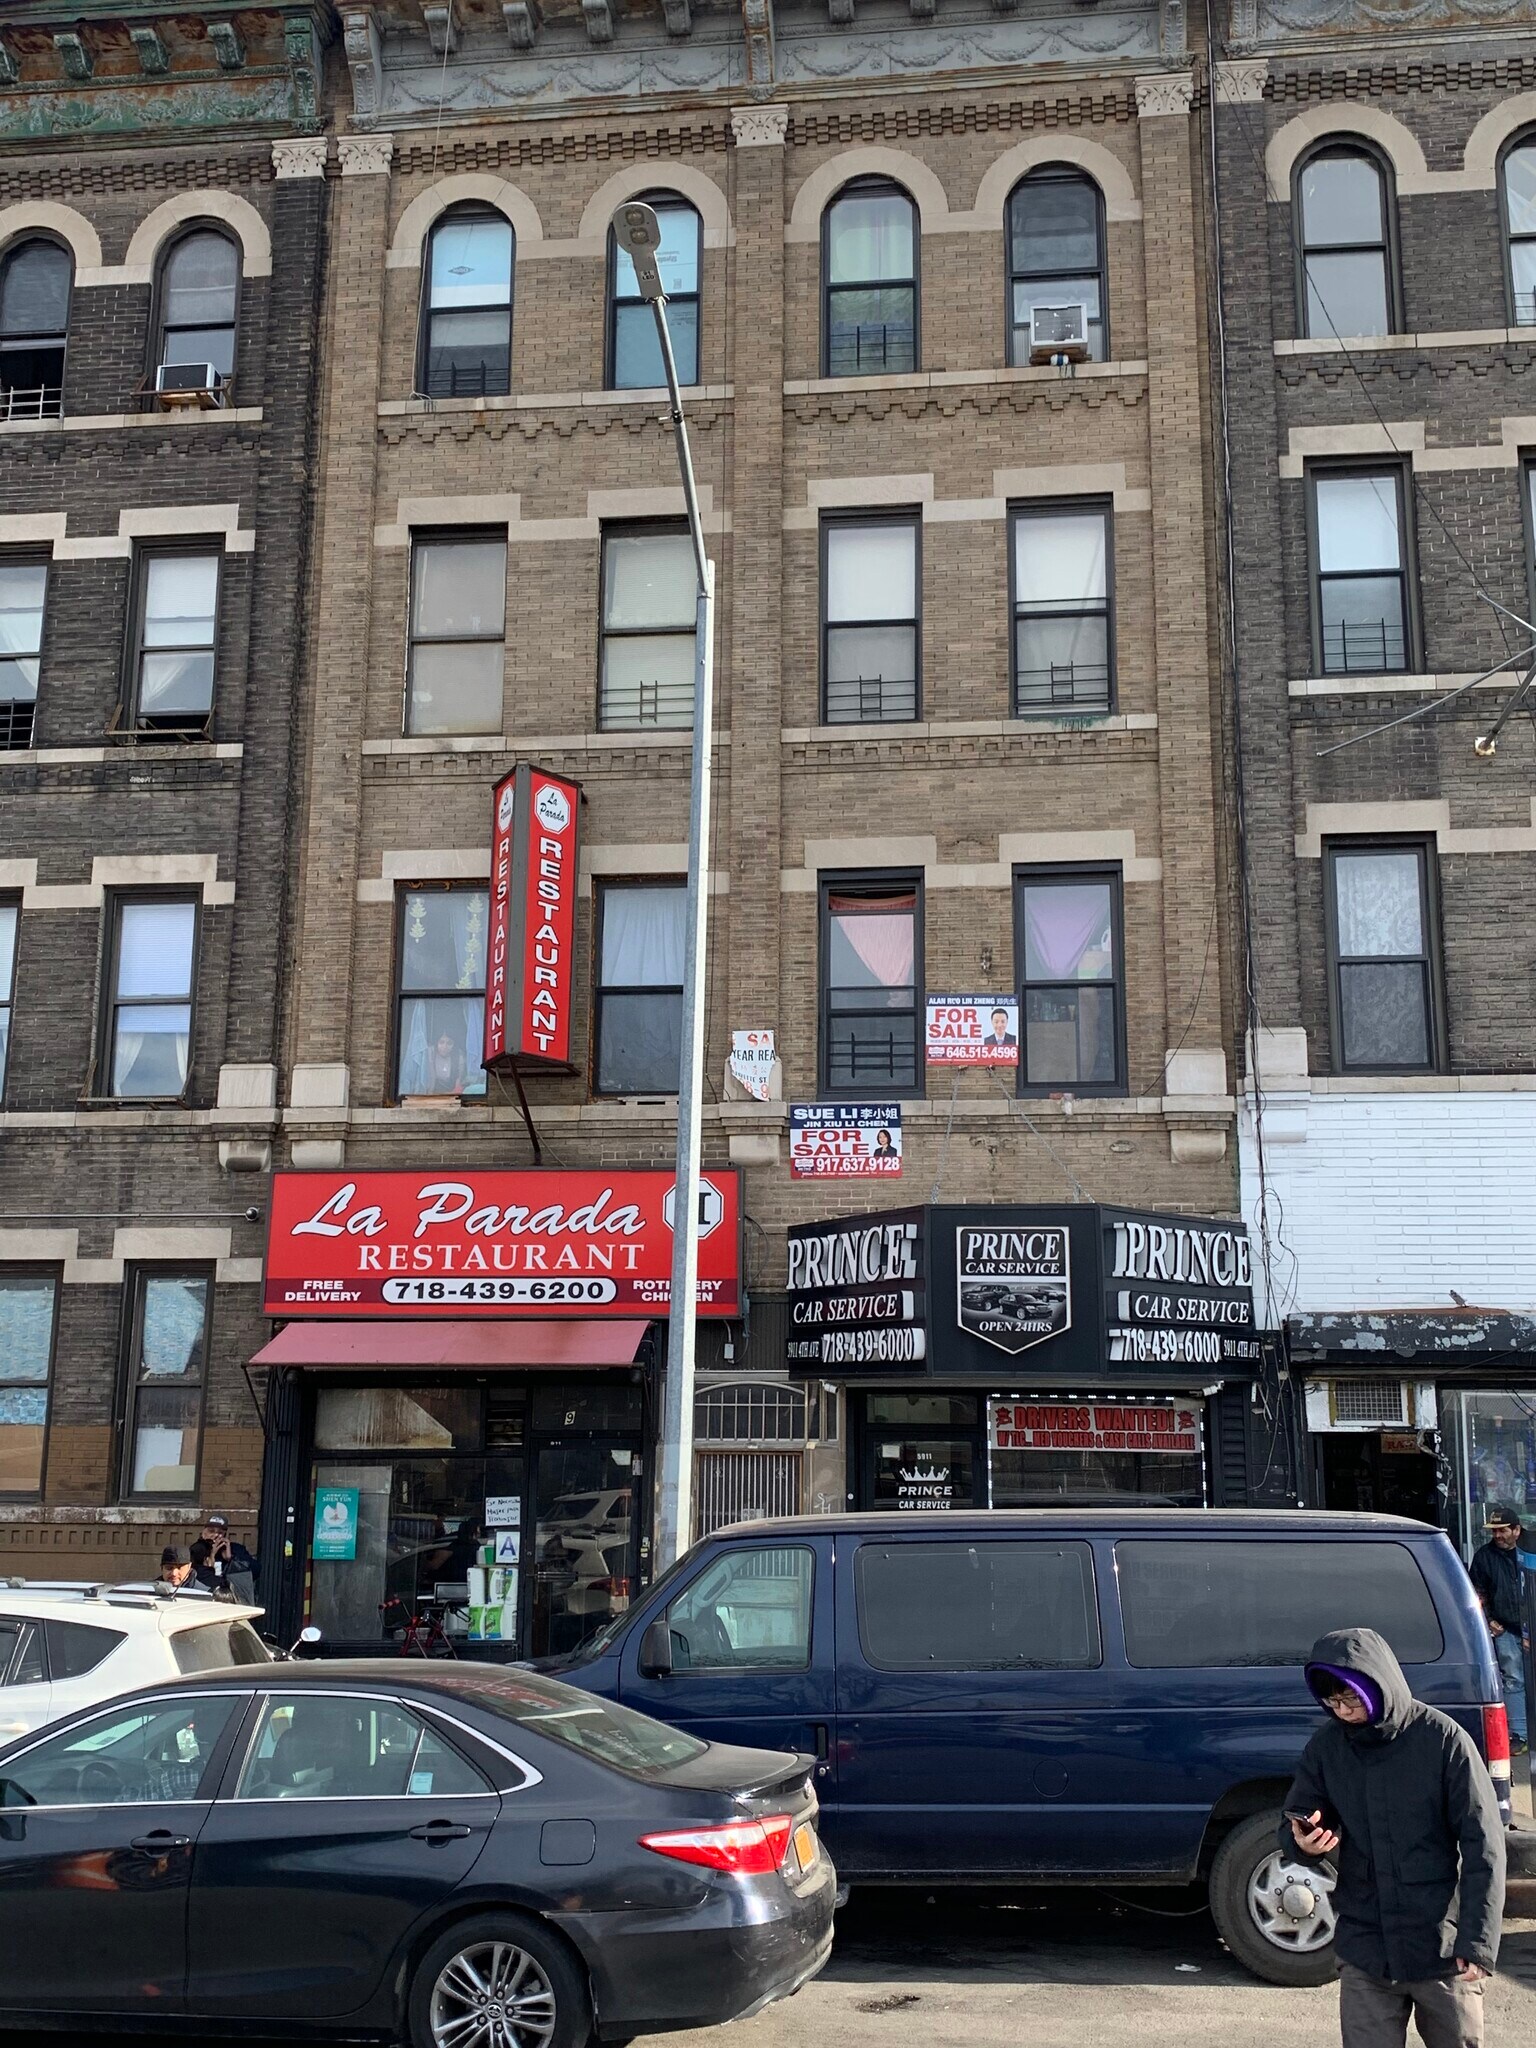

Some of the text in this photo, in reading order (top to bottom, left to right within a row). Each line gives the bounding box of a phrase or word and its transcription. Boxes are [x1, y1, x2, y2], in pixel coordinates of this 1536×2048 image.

[540, 803, 565, 823] Parada
[491, 836, 510, 1051] RESTAURANT
[532, 836, 562, 1052] RESTAURANT
[928, 997, 946, 1005] ALAN
[935, 1008, 977, 1023] FOR
[928, 1023, 982, 1039] SALE
[946, 1047, 1018, 1059] 646.515.4596
[793, 1107, 899, 1120] SUE LI 李小姐
[801, 1130, 862, 1143] FOR
[793, 1143, 870, 1156] SALE
[816, 1158, 900, 1172] 917.637.9128
[290, 1182, 388, 1237] La
[413, 1182, 647, 1238] Parada
[965, 1233, 1060, 1261] PRINCE
[1125, 1222, 1253, 1287] PRINCE
[357, 1243, 645, 1271] RESTAURANT
[786, 1224, 907, 1290] PRINCE
[965, 1262, 1060, 1274] CAR SERVICE
[303, 1280, 344, 1290] FREE
[395, 1281, 604, 1300] 718-439-6200
[633, 1280, 723, 1290] ROTIERY
[284, 1291, 361, 1302] DELIVERY
[641, 1291, 713, 1302] CHIEN
[793, 1294, 898, 1324] CAR SERVICE
[1134, 1295, 1250, 1324] CAR SERVICE
[979, 1321, 1053, 1332] OPEN 24HRS
[822, 1328, 913, 1363] 718-439-6000
[1121, 1328, 1220, 1363] 718-439-6000
[567, 1412, 574, 1424] 9
[1014, 1406, 1175, 1432] DRIVERS WANTED!
[1051, 1431, 1095, 1448] VOUCHERS
[1103, 1432, 1126, 1449] CASH
[1127, 1432, 1152, 1449] CALLS
[1152, 1433, 1196, 1450] AVAILABLE
[898, 1486, 953, 1496] PRINCE
[899, 1501, 951, 1510] CAR SERVICE
[499, 1535, 517, 1556] A
